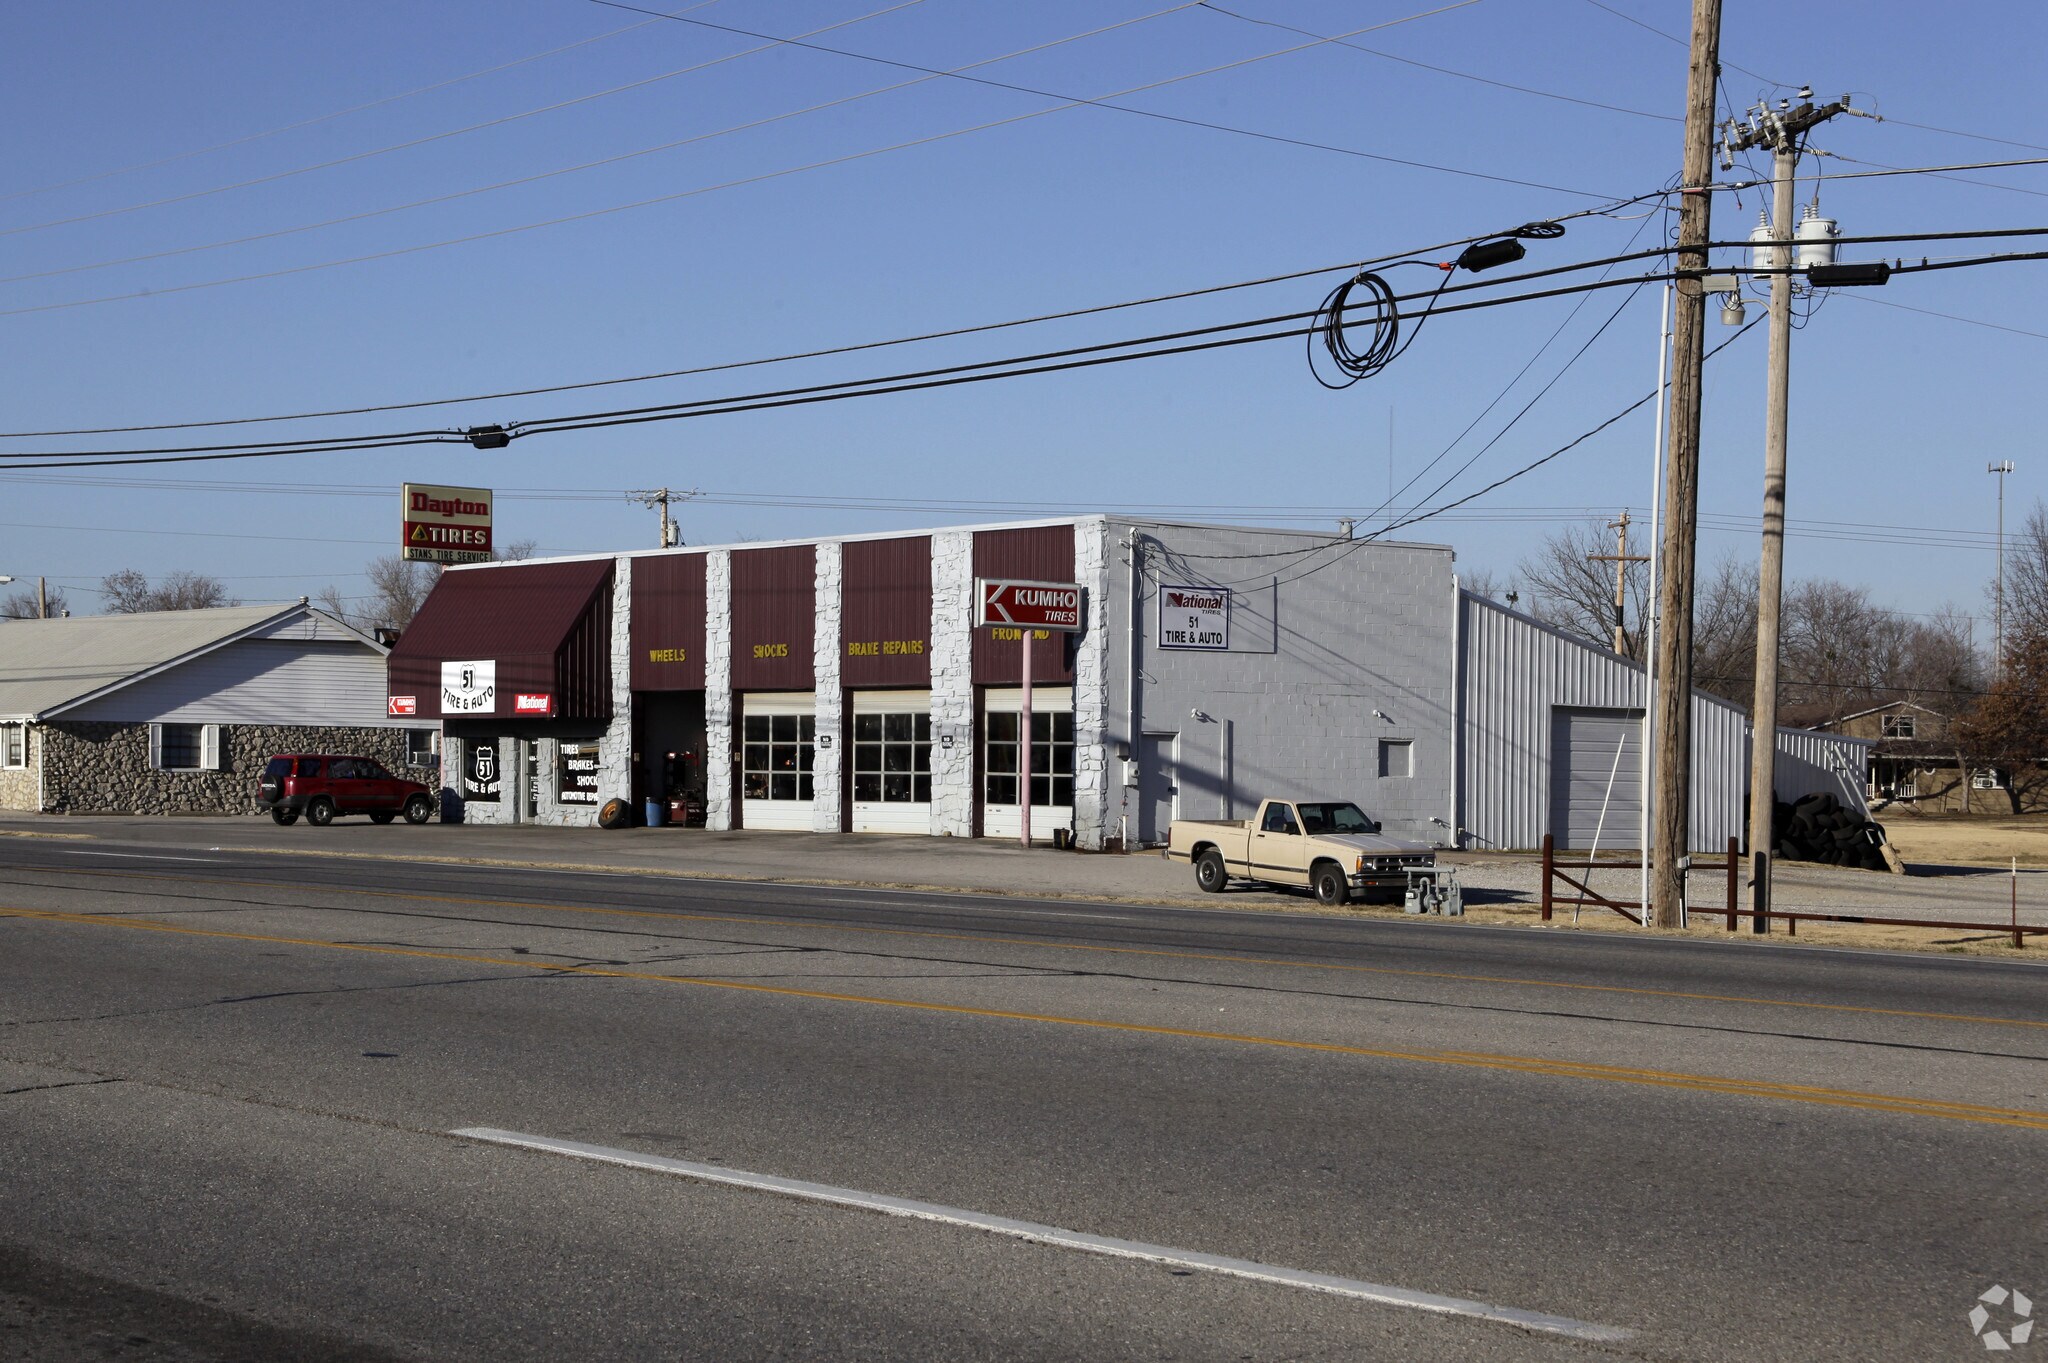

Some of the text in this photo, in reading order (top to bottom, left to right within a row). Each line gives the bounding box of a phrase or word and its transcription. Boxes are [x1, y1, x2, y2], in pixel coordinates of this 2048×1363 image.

[410, 492, 489, 518] Dayton
[429, 527, 487, 545] TIRES
[409, 548, 489, 562] STANS TIRE SERVICE
[1015, 589, 1077, 609] KUMHO
[1165, 592, 1224, 609] National
[1045, 610, 1076, 623] TIRES
[1188, 616, 1199, 629] 51
[992, 627, 1050, 641] FRON ND
[1165, 630, 1223, 645] TIRE & AUTO
[649, 648, 686, 662] WHEELS
[753, 643, 789, 659] SHOCKS
[848, 640, 924, 656] BRAKE REPAIRS
[462, 669, 474, 689] 51
[443, 685, 494, 710] TIRE & AUTO
[517, 695, 549, 709] National
[560, 744, 579, 755] TIRES
[479, 761, 491, 776] 51
[567, 760, 594, 771] BRAKES
[464, 777, 501, 795] TIRE & AUT
[576, 775, 599, 787] SHOCK
